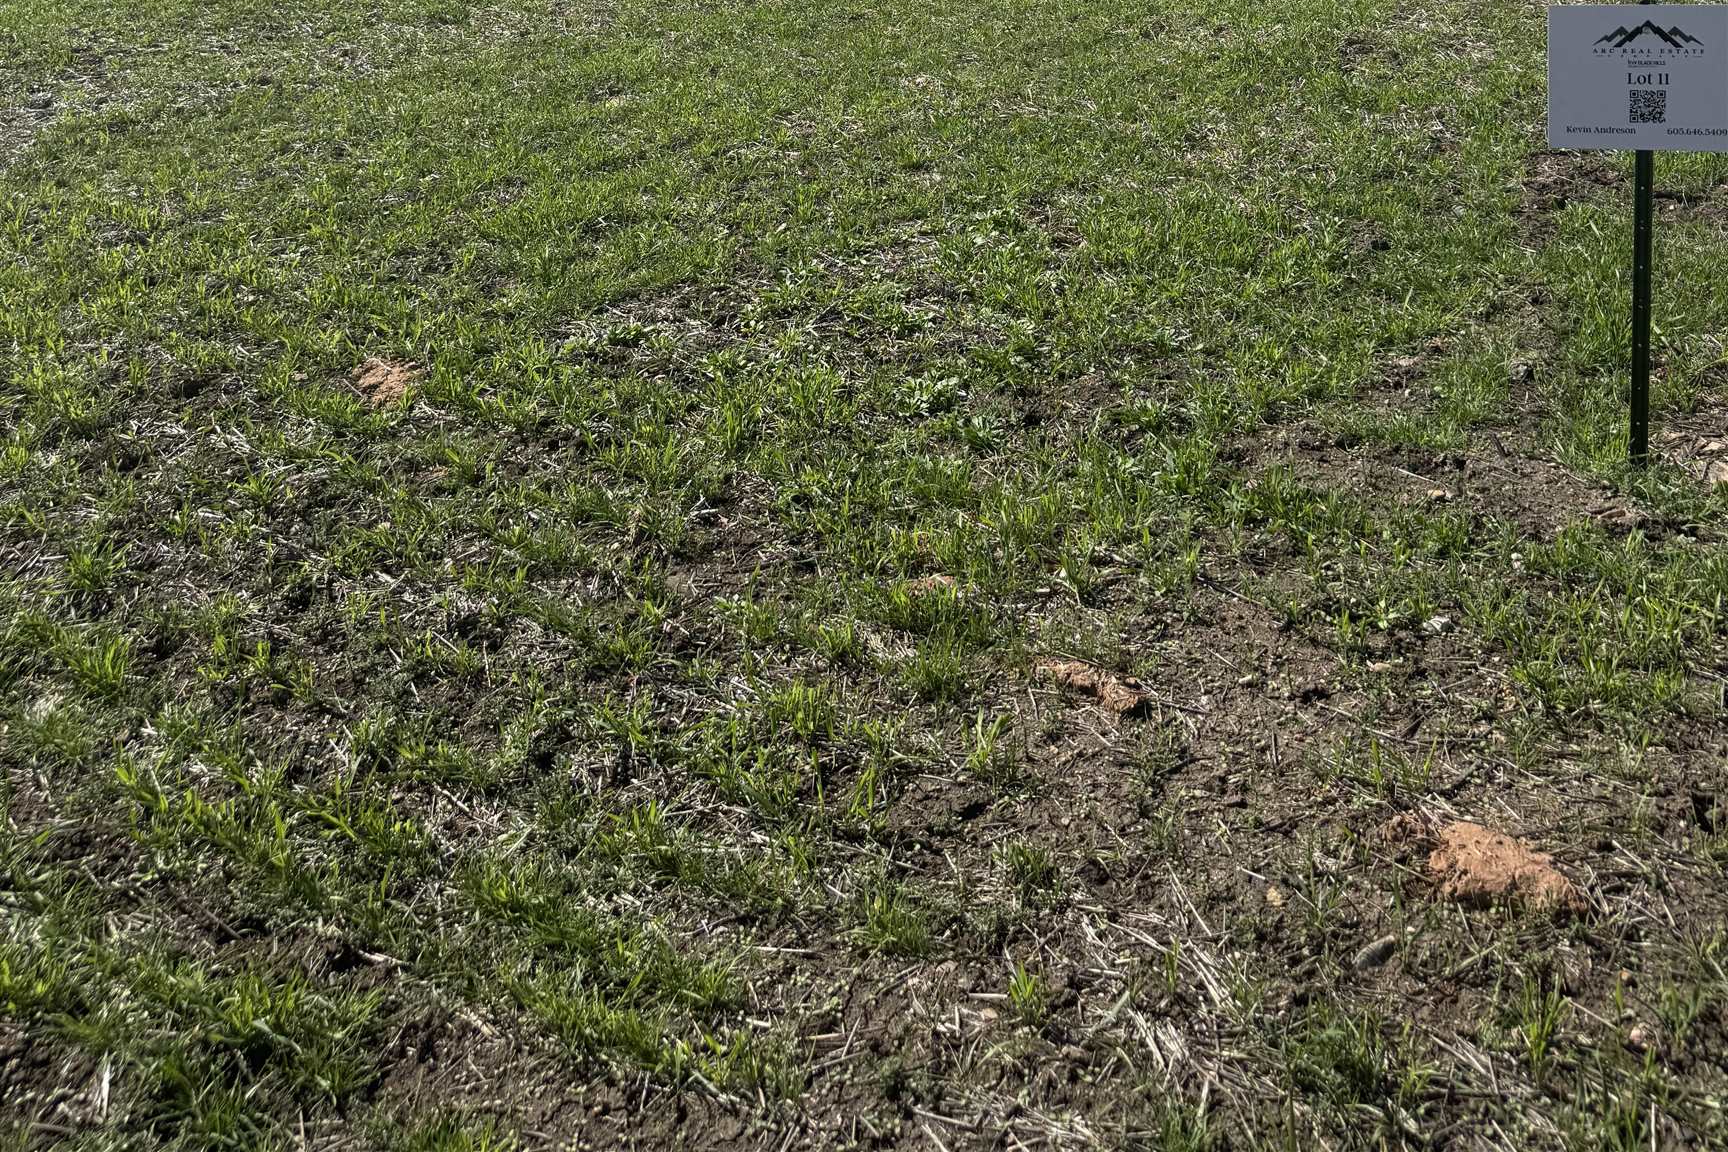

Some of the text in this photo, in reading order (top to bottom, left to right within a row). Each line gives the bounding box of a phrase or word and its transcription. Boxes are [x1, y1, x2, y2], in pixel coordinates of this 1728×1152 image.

[1627, 72, 1669, 85] Lot 11
[1566, 125, 1592, 134] Kevin
[1593, 125, 1637, 135] Andreson
